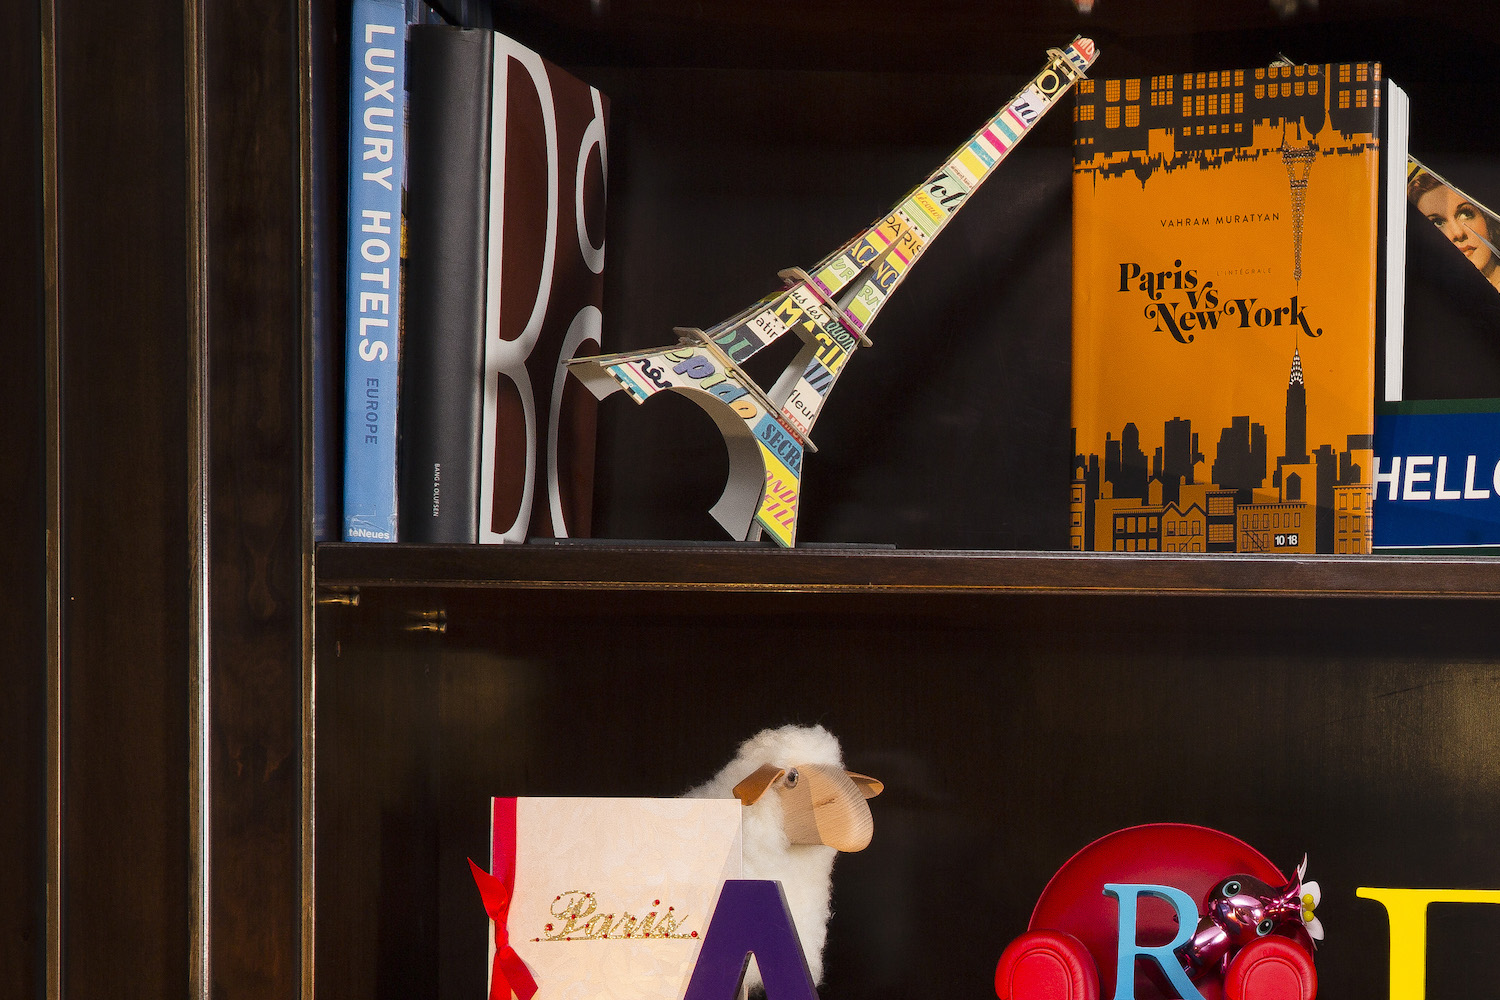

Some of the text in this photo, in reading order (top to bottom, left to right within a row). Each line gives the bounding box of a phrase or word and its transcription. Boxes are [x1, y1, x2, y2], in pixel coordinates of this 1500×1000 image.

[359, 24, 395, 361] LUXURY HOTELS
[1160, 212, 1280, 228] VAHRAM MURATYAN
[1117, 259, 1198, 301] Paris
[1185, 281, 1219, 310] vs
[1144, 295, 1323, 344] New York
[365, 378, 379, 445] EUROPE
[533, 889, 701, 941] Paris
